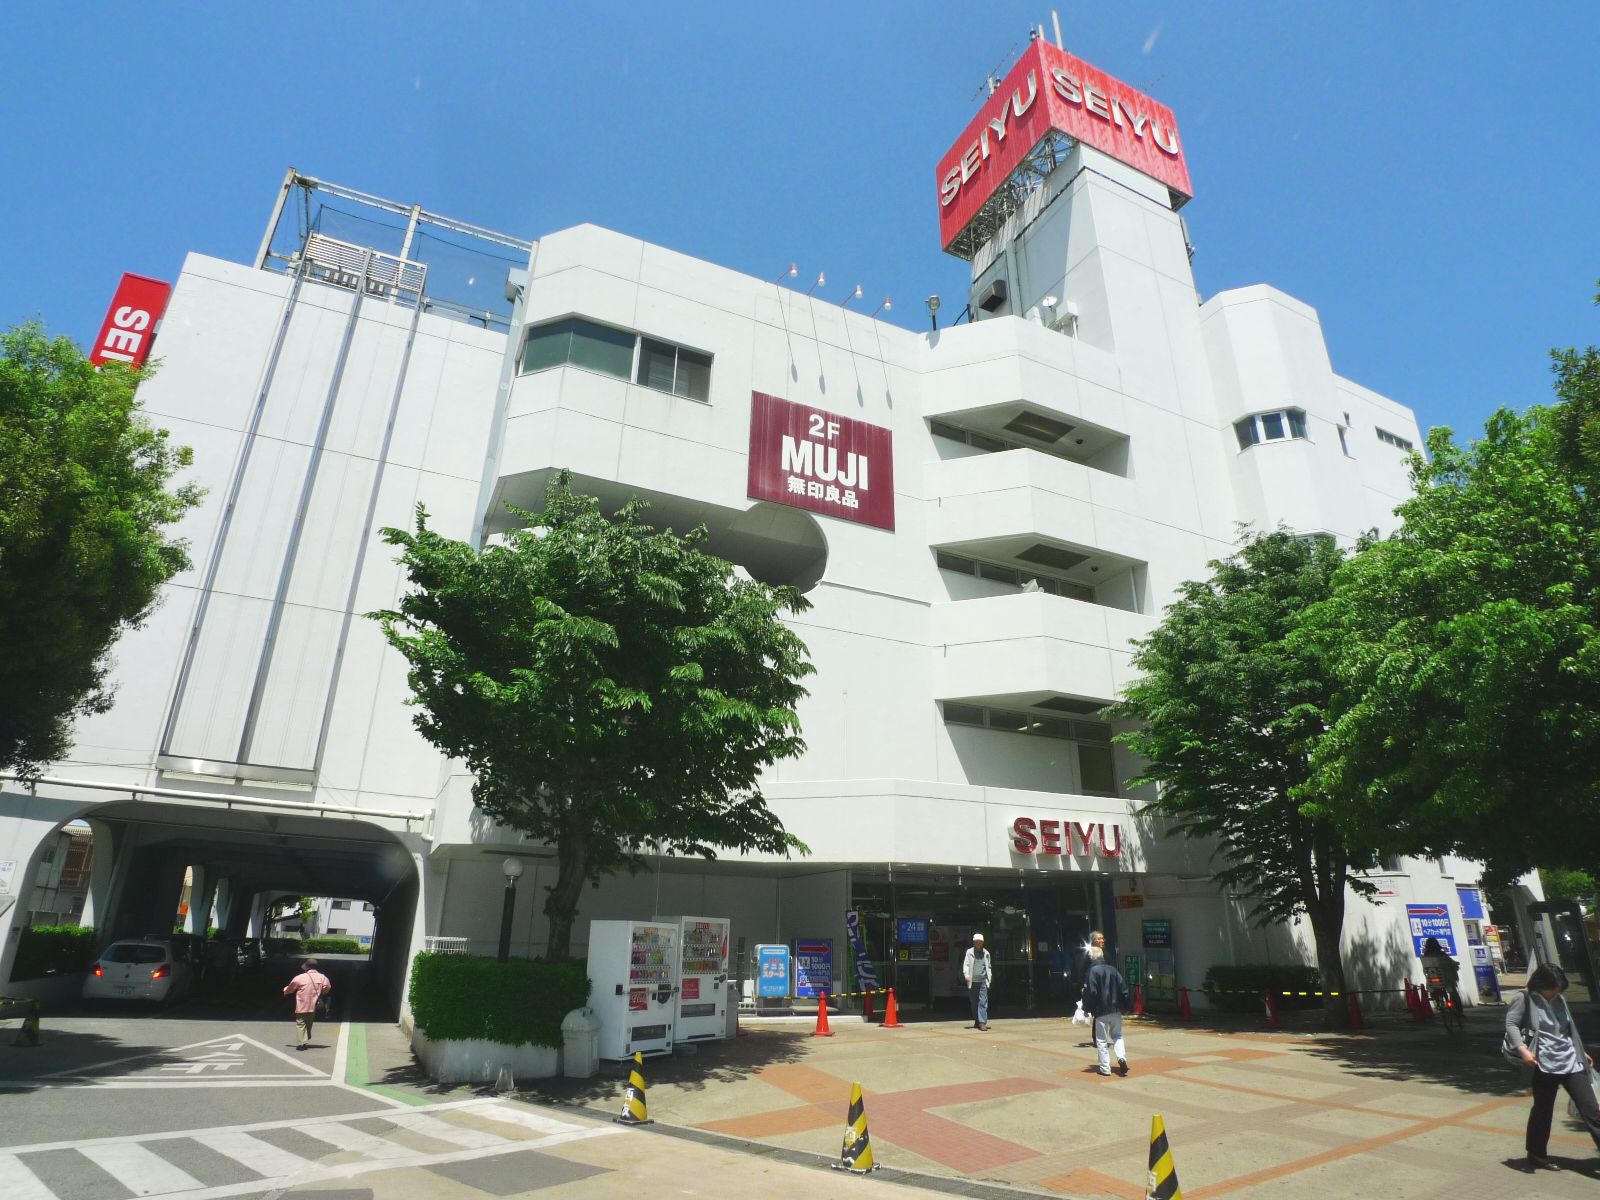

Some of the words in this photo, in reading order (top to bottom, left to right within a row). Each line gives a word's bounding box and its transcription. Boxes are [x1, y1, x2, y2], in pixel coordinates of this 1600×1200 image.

[941, 69, 1037, 206] SEIYU
[1052, 67, 1179, 155] SEIYU
[98, 305, 151, 366] SEI
[808, 413, 840, 440] 2F
[781, 434, 869, 491] MUJI
[787, 475, 859, 509] 無印良品
[1010, 816, 1122, 858] SEIYU
